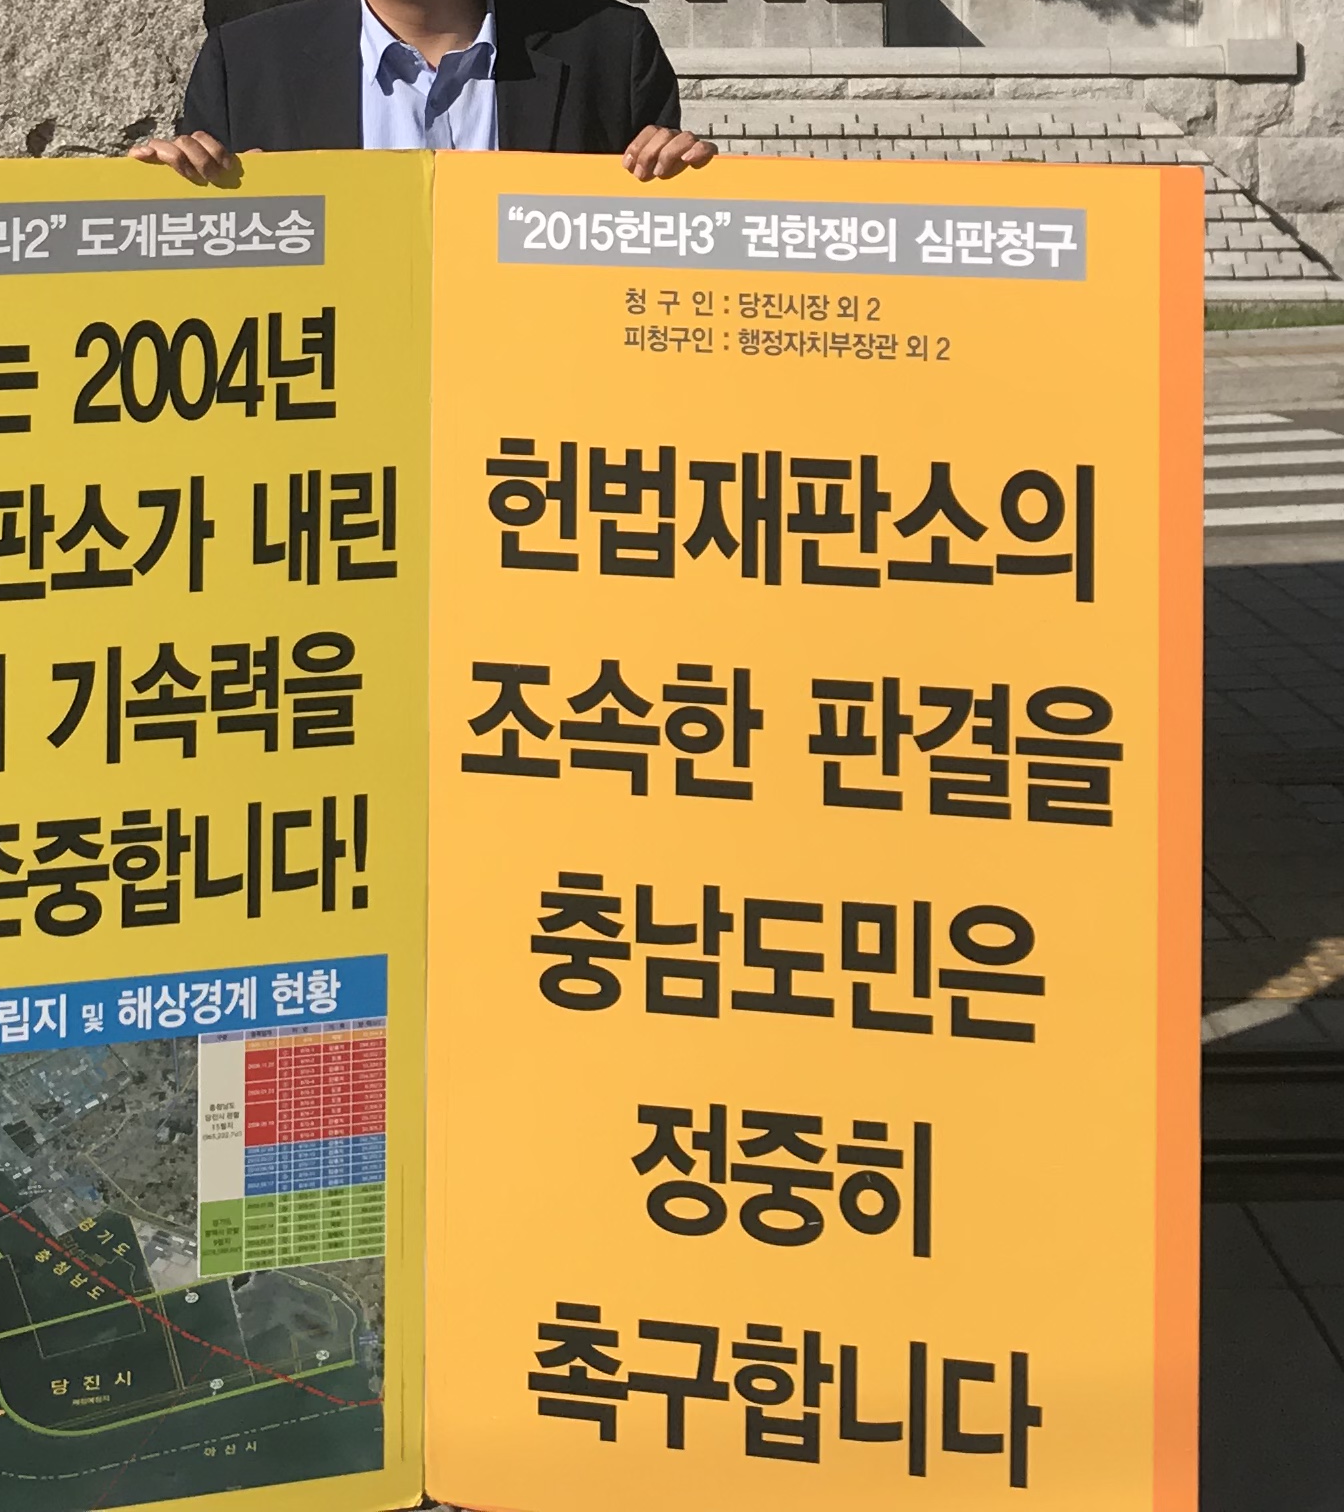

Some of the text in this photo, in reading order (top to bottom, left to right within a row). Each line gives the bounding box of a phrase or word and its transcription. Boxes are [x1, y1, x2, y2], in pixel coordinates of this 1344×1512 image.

[77, 210, 314, 257] 도계분쟁소송
[509, 206, 1077, 267] “2015헌라3” 권한쟁의 심판청구
[74, 307, 336, 424] 2004년
[624, 326, 713, 353] 피청구인
[739, 329, 898, 359] 행정자치부장관
[906, 335, 927, 361] 외
[936, 337, 950, 360] 2
[739, 293, 830, 321] 당진시장
[837, 296, 858, 321] 외
[867, 298, 880, 321] 2
[253, 466, 397, 585] 내린
[486, 438, 1094, 603] 헌법재판소의
[47, 632, 362, 764] 기속력을
[461, 660, 1123, 827] 조속한 판결을
[82, 1003, 103, 1033] 및
[118, 976, 257, 1032] 해상경계
[272, 969, 341, 1016] 현황
[531, 872, 1045, 1043] 충남도민은
[631, 1104, 931, 1258] 정중히
[528, 1302, 1042, 1488] 촉구합니다
